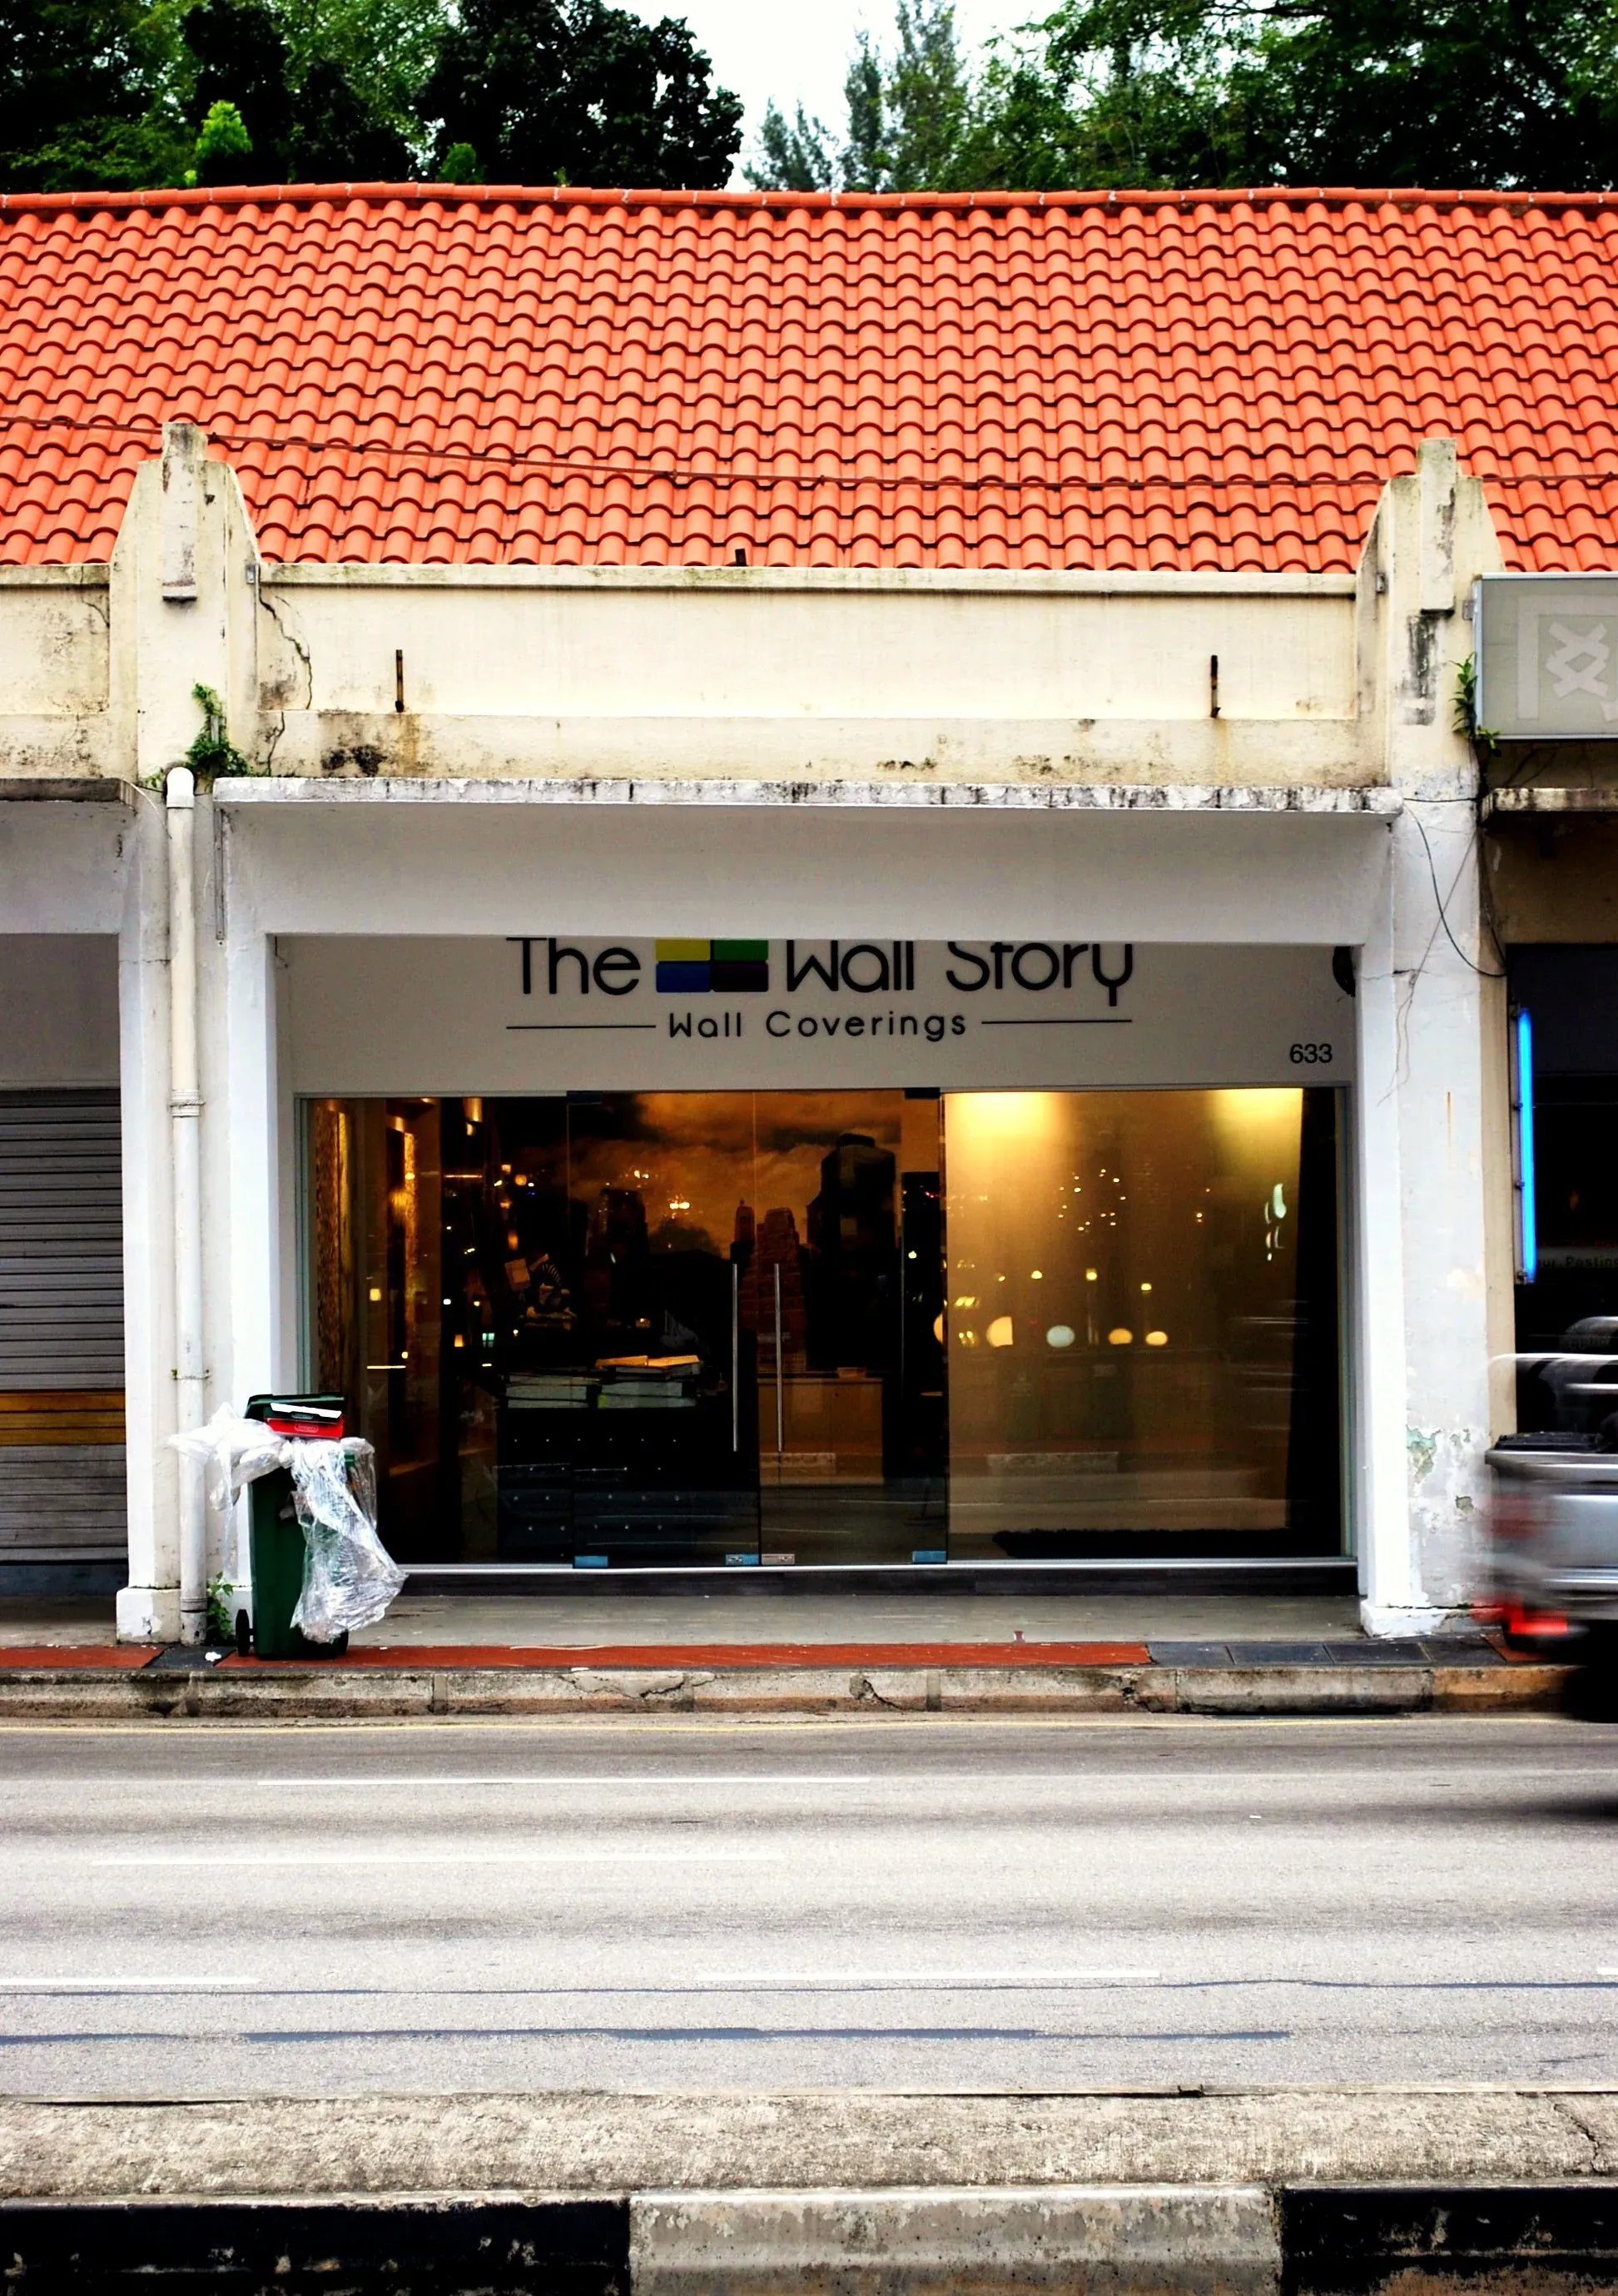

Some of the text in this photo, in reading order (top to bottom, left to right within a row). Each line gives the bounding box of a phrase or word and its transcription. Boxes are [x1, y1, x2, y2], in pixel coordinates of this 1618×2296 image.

[505, 937, 1133, 1006] The Wall Story
[669, 1010, 965, 1042] Wall Coverings
[1289, 1043, 1333, 1064] 633
